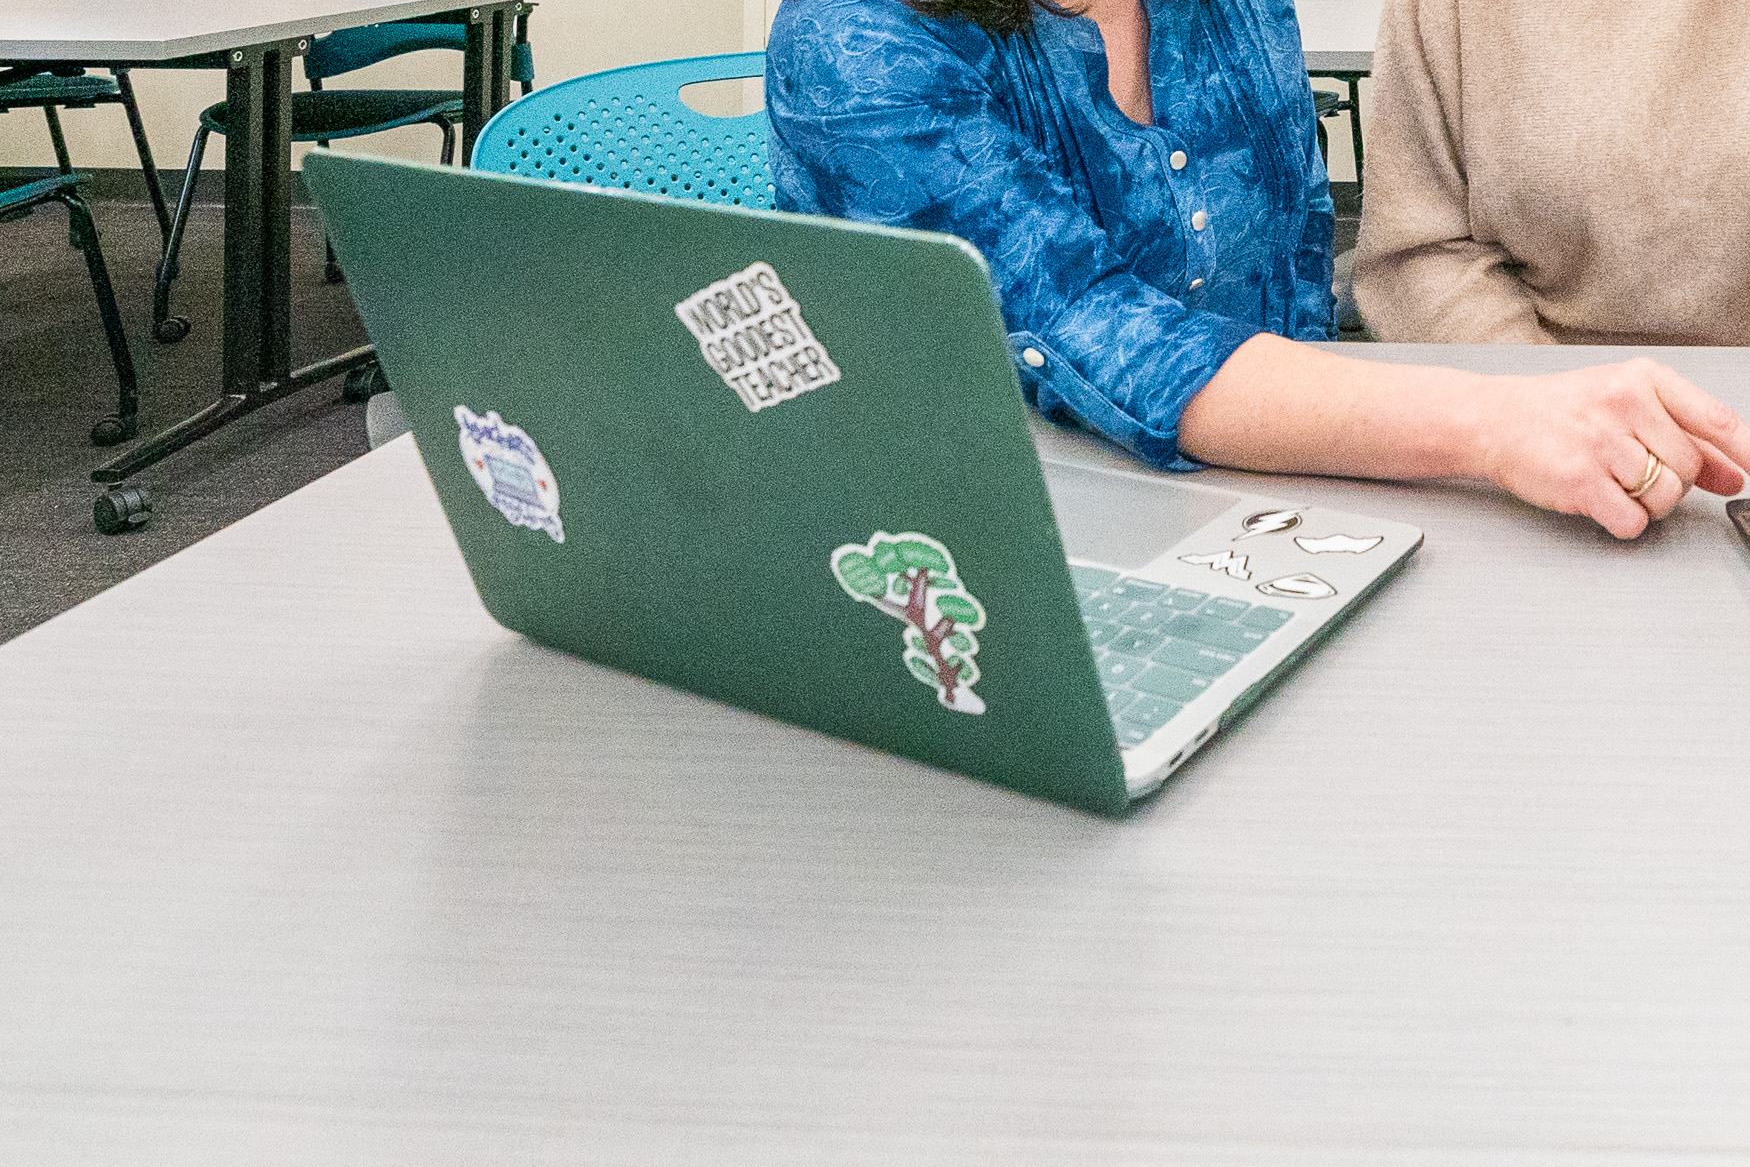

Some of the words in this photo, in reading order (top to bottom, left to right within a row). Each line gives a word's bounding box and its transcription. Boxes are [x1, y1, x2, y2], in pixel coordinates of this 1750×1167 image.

[687, 271, 783, 335] WORLD'S
[706, 307, 808, 374] GOODEST
[730, 345, 834, 406] TEACHER
